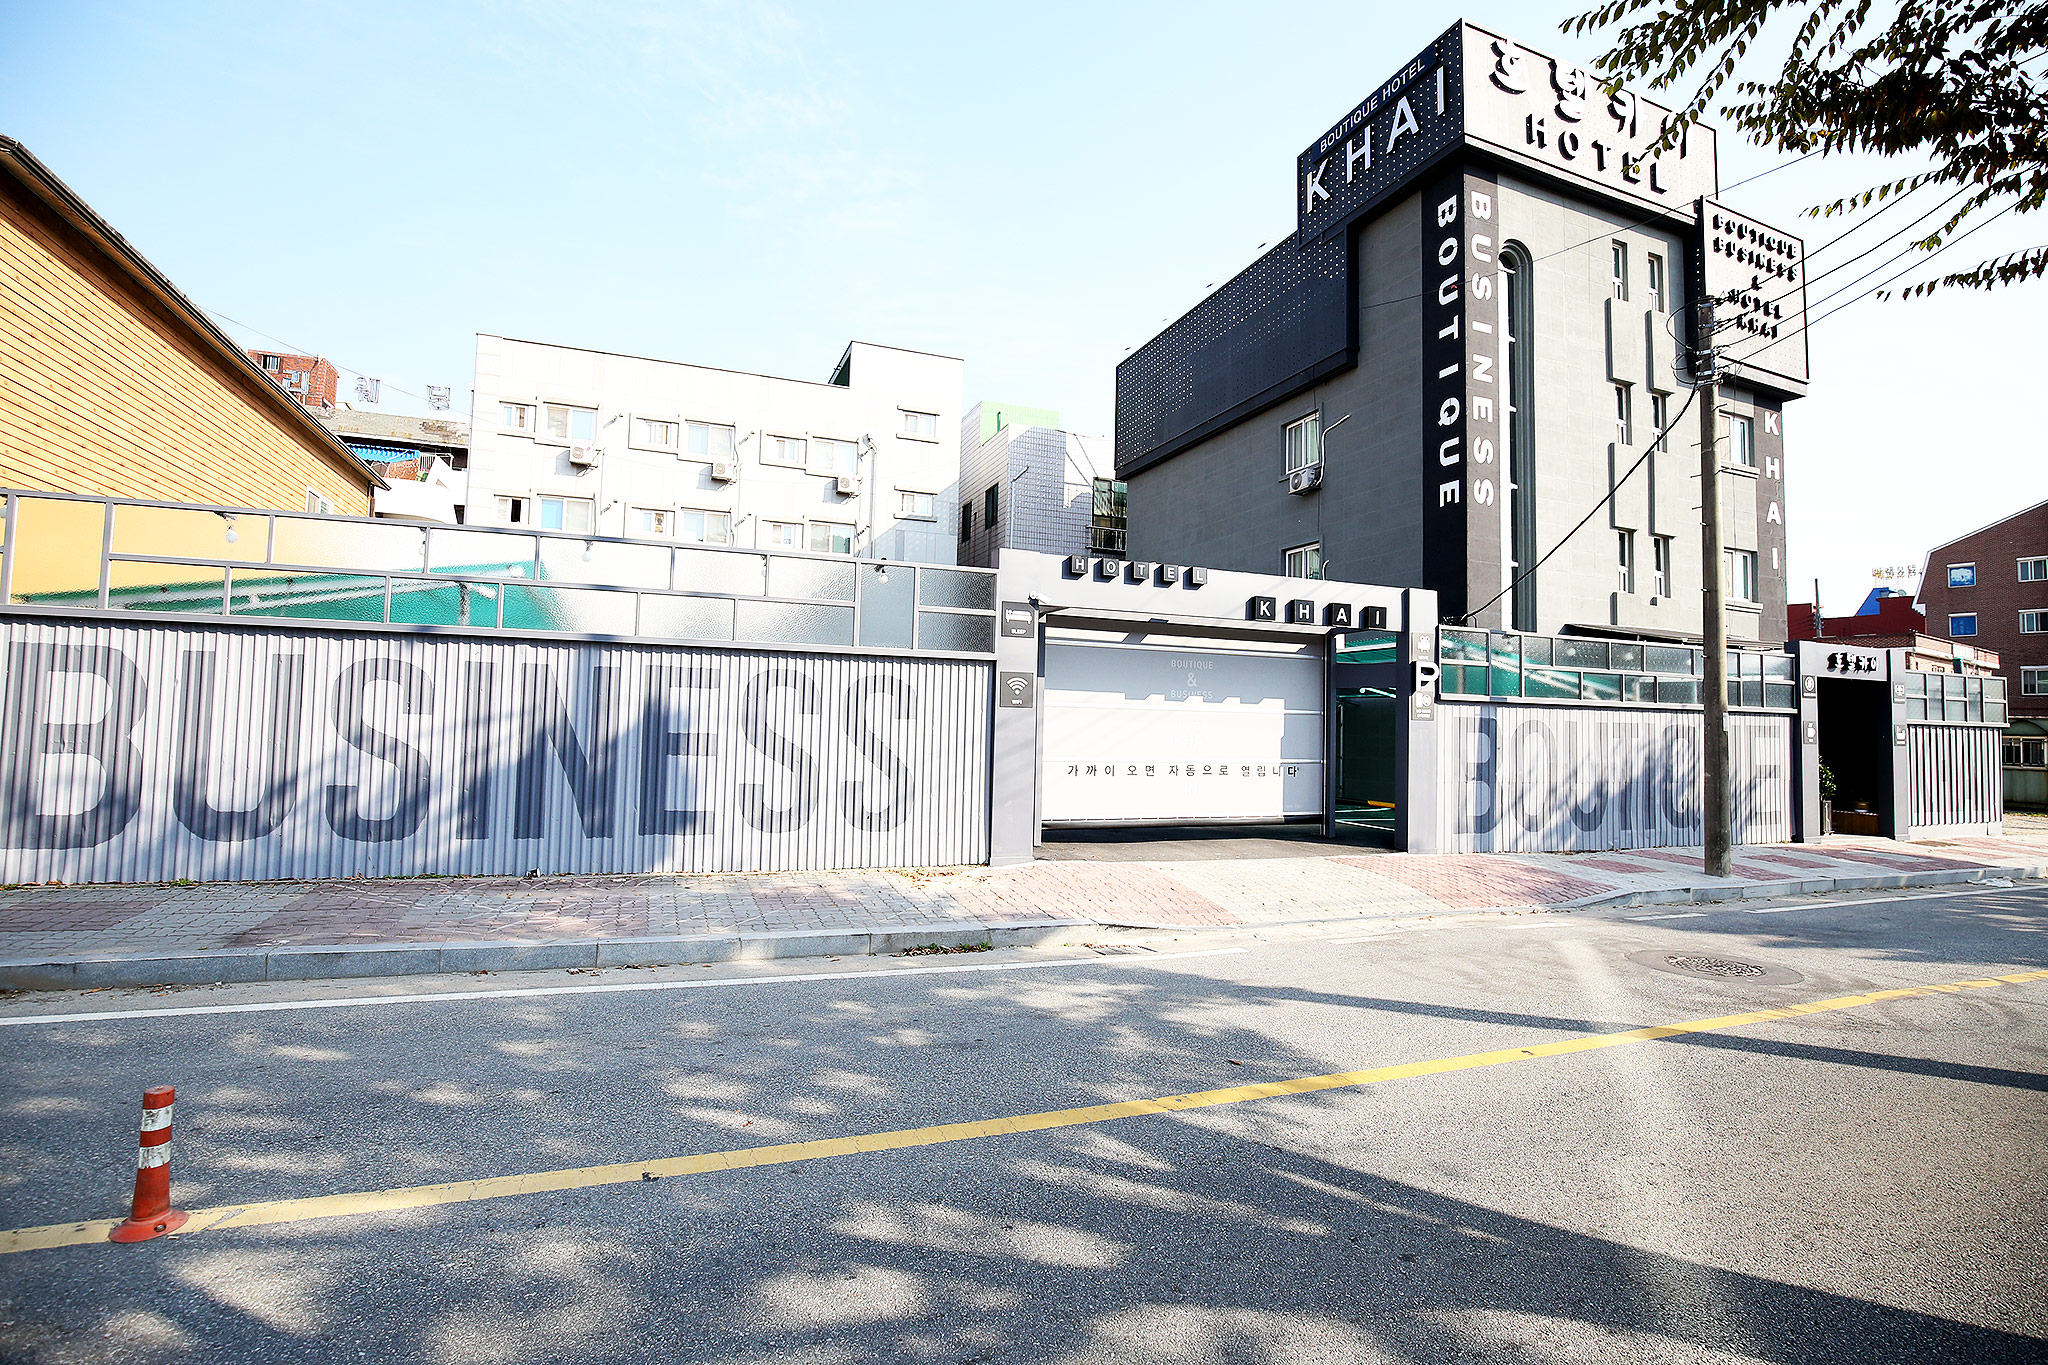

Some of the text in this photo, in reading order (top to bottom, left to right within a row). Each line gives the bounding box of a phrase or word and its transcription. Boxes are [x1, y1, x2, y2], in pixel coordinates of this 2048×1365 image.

[1320, 58, 1426, 153] BOUTIQUE HOTEL
[1306, 65, 1445, 214] KHAI
[1526, 113, 1669, 195] HOTEL
[1713, 213, 1798, 260] BOUTIQUE
[1713, 237, 1798, 283] BUSINESS
[1437, 194, 1461, 508] BOUTIQUE
[1470, 190, 1495, 507] BUSINESS
[1763, 410, 1782, 570] KHAI
[1074, 557, 1205, 582] HOTEL
[1259, 600, 1380, 626] KHAI
[1171, 659, 1213, 670] BOUTIQUE
[1186, 672, 1197, 687] &
[1416, 661, 1441, 692] P
[1170, 689, 1213, 700] BUSINESS
[0, 642, 919, 849] BUSINESS
[1067, 764, 1299, 778] 가까이 오면 자동으로 열립니다
